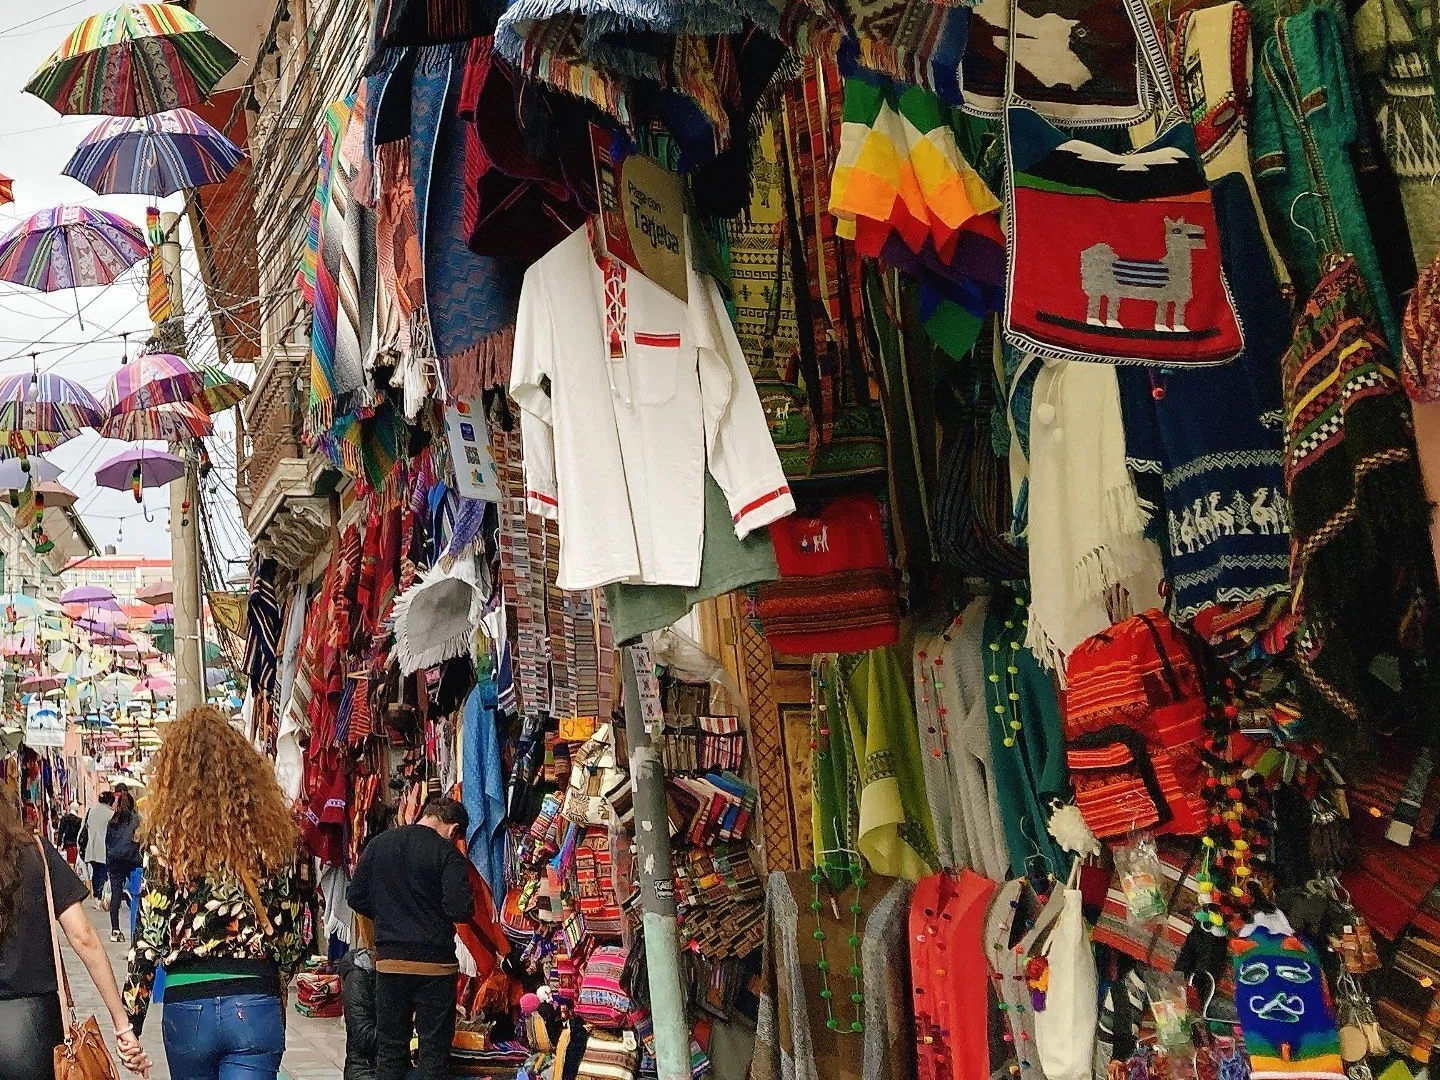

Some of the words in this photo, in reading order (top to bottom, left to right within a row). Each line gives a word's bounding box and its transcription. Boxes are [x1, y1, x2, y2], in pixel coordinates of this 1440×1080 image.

[627, 179, 647, 206] Paga
[647, 197, 663, 215] con
[630, 201, 680, 256] Tarjeta
